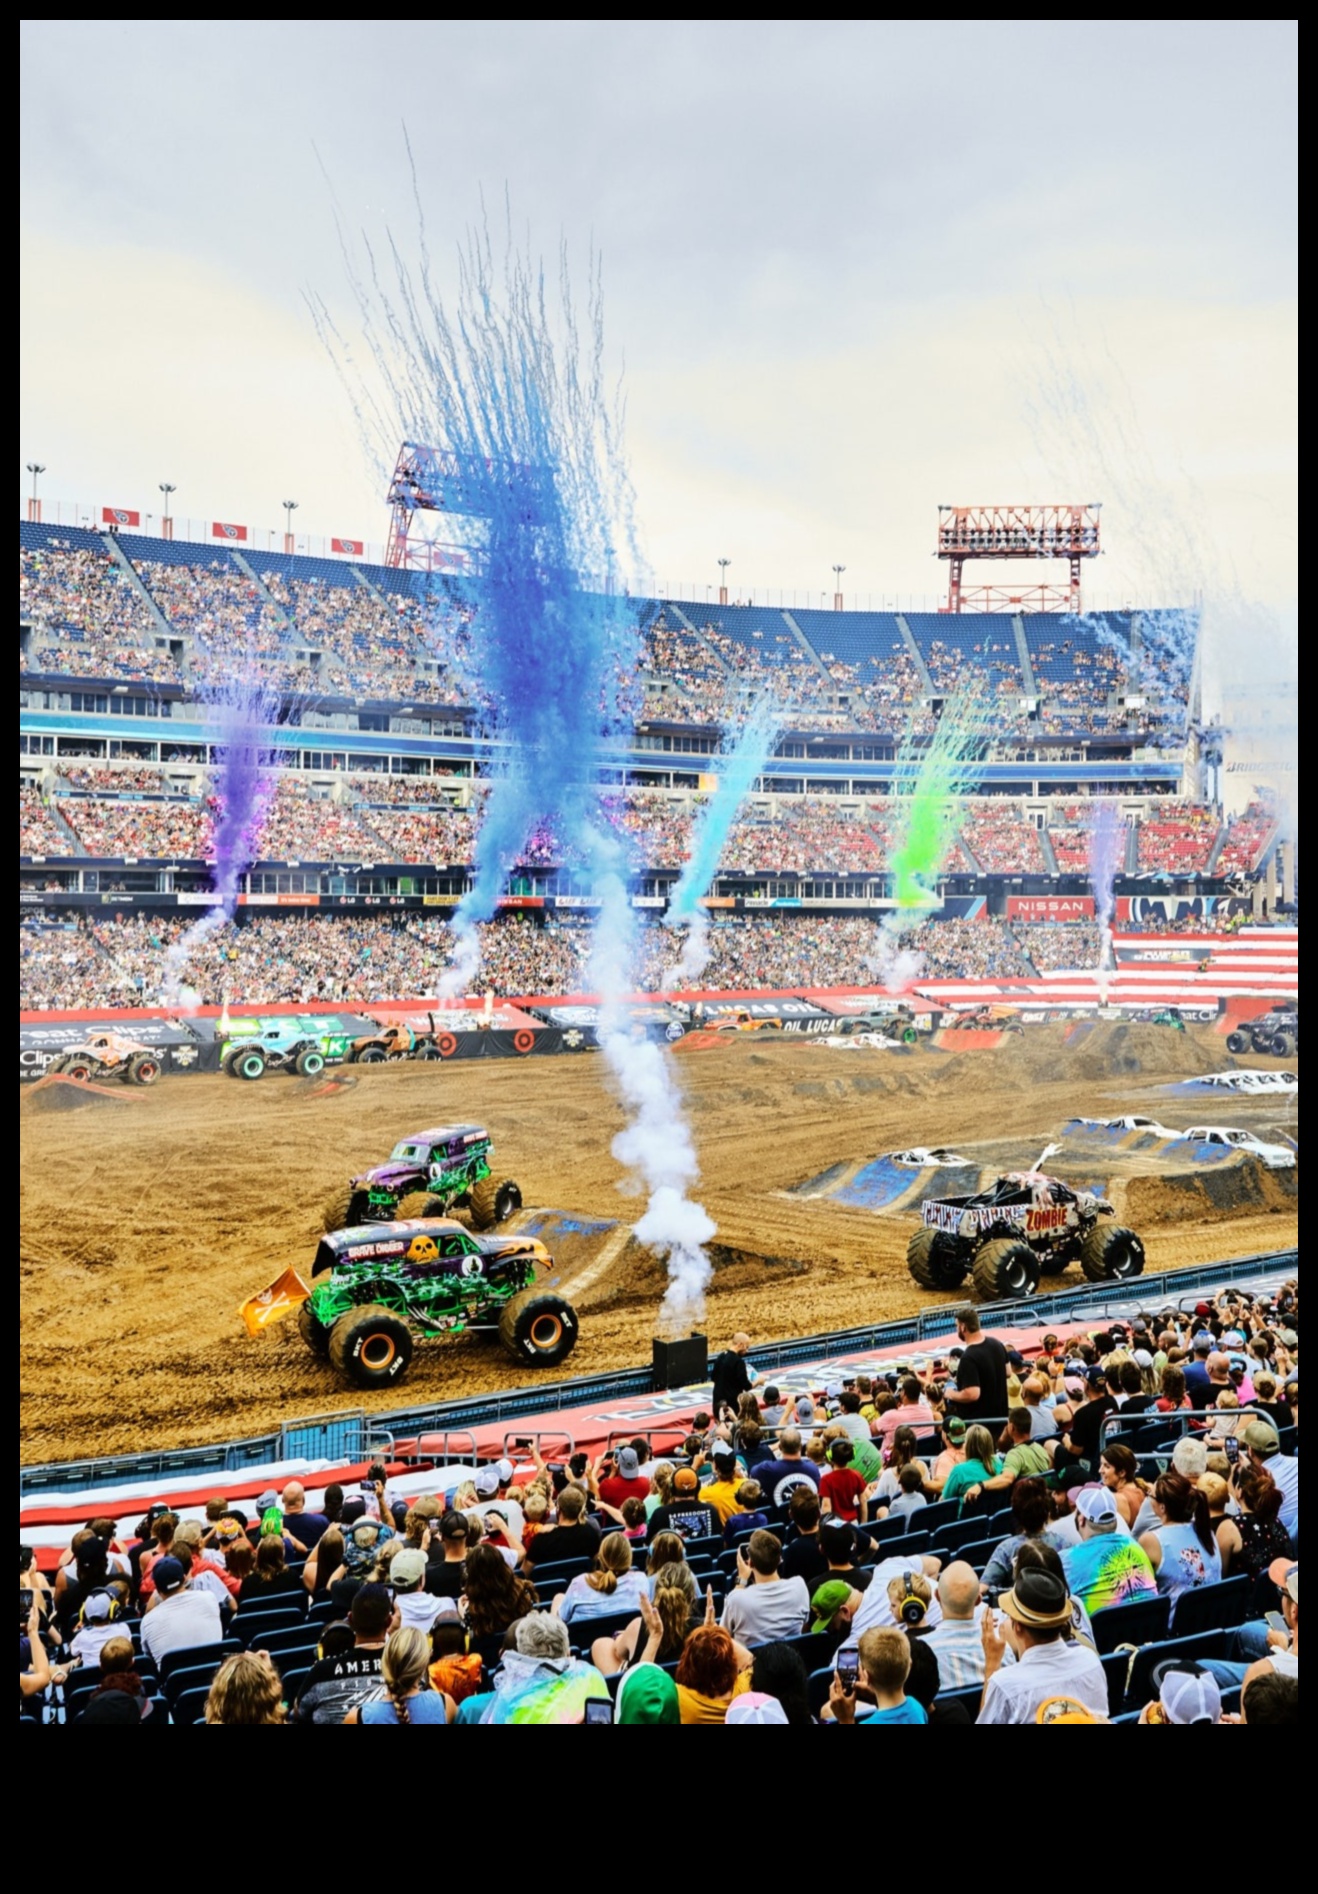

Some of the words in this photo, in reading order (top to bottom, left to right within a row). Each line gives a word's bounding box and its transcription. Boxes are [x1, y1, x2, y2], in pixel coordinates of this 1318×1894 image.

[1018, 901, 1084, 911] NISSAN
[782, 1003, 822, 1014] OIL
[85, 1025, 161, 1036] Clips
[784, 1021, 802, 1032] OIL
[20, 1050, 61, 1068] Clips
[30, 1069, 48, 1077] GRE
[1025, 1208, 1068, 1232] ZOMBIE
[348, 1243, 375, 1258] GRAVE
[375, 1240, 404, 1254] DIGGER
[560, 1311, 573, 1328] BKT
[352, 1336, 363, 1357] BKT
[523, 1338, 537, 1354] BKT
[389, 1355, 404, 1376] BKT
[334, 1658, 382, 1675] AMER
